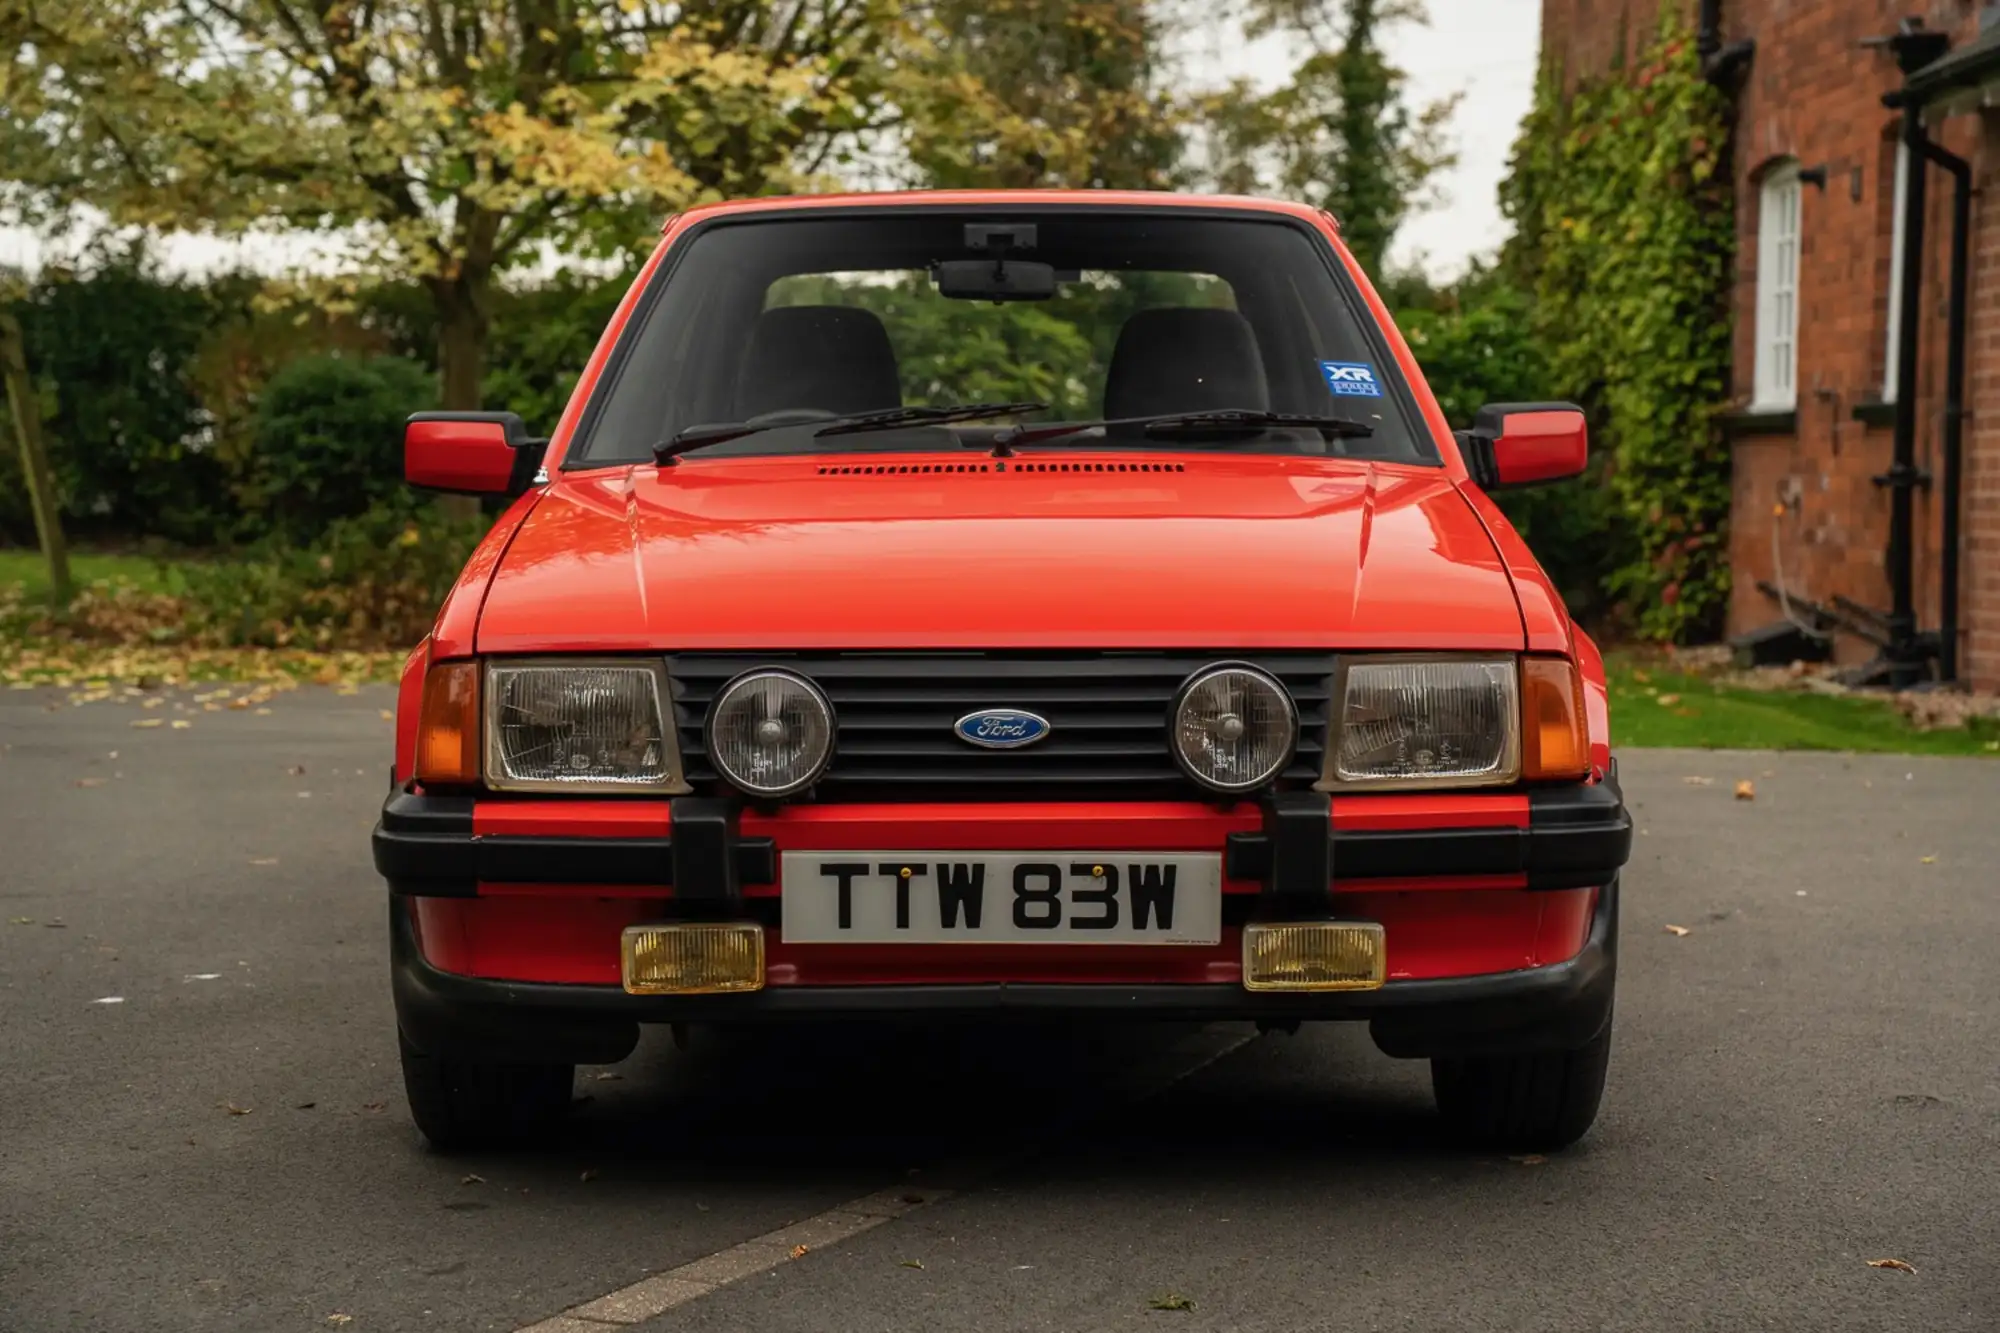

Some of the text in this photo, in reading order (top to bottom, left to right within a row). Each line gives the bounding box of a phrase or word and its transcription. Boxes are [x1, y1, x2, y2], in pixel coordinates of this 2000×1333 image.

[1325, 366, 1374, 382] XR
[976, 716, 1026, 736] Ford
[820, 863, 1177, 930] TTW 83W
